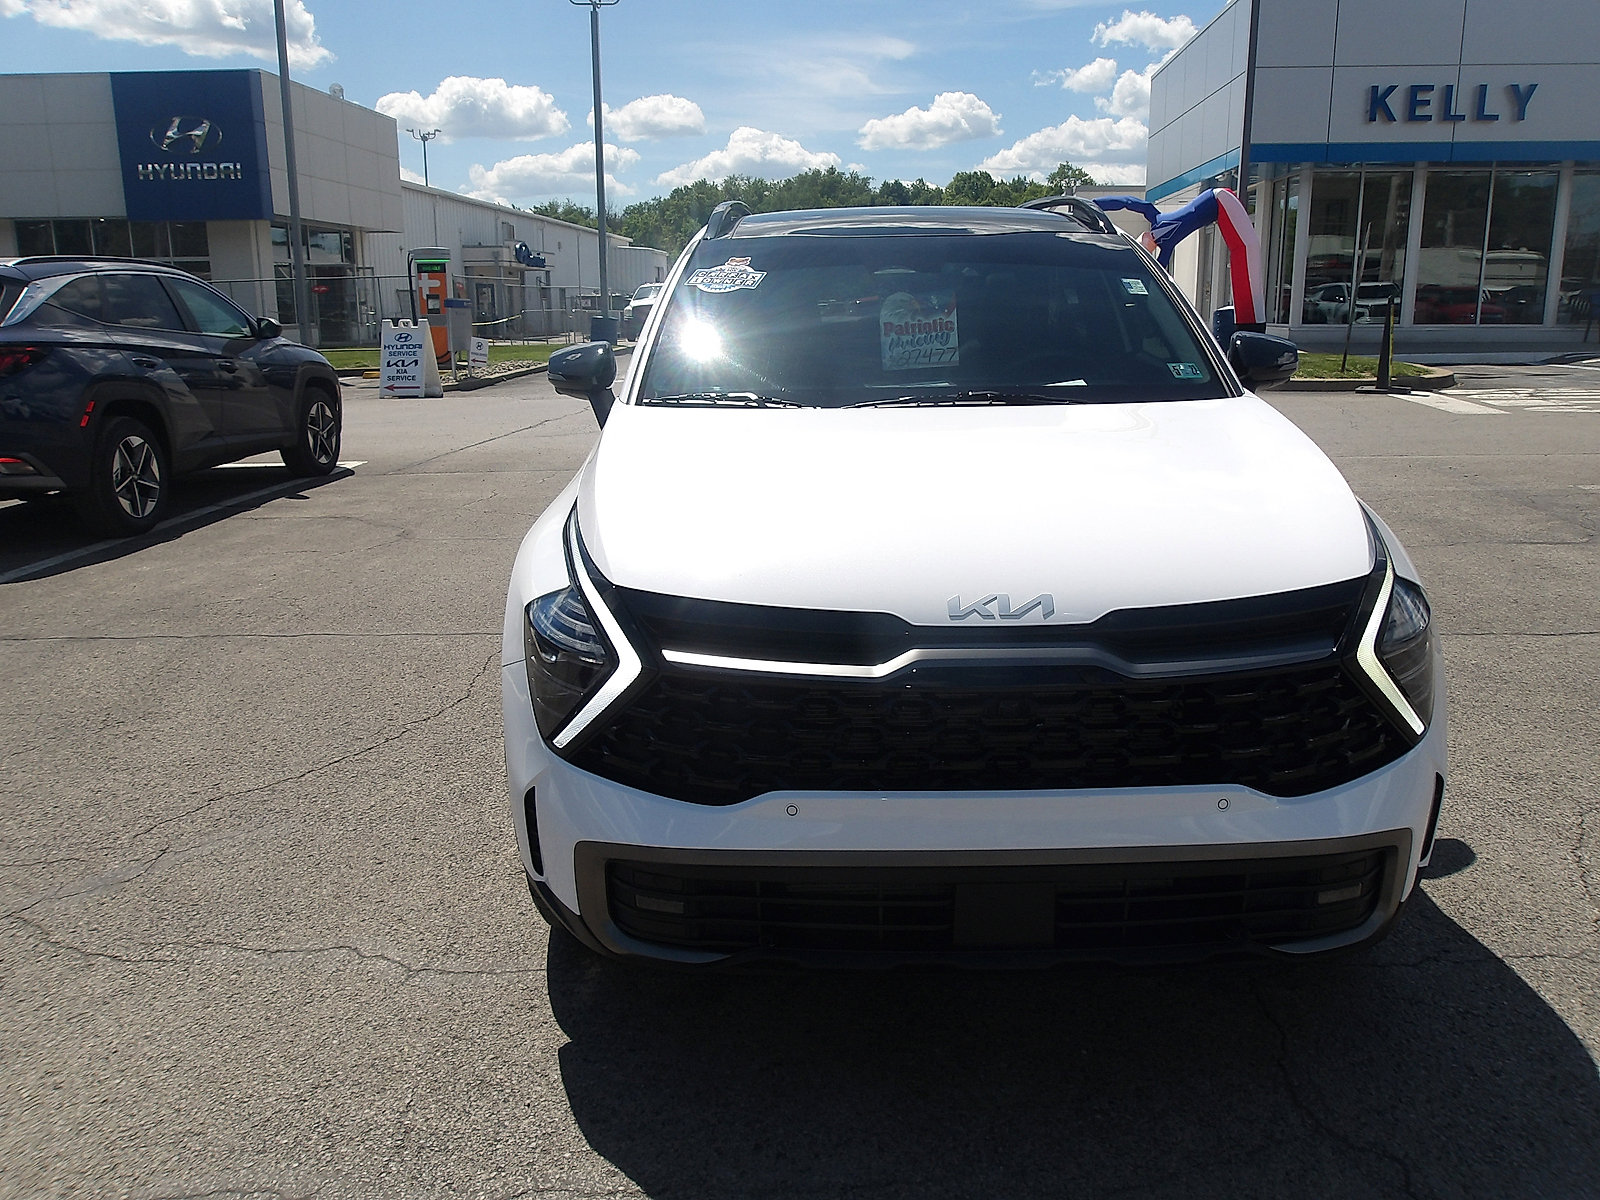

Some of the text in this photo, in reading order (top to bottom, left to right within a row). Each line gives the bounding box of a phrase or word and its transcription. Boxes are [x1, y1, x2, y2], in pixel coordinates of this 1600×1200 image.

[1368, 83, 1539, 122] KELLY
[137, 162, 242, 180] HYUNDAI
[883, 317, 956, 338] Patriotic
[386, 359, 419, 367] KIA
[947, 593, 1055, 621] KIA
